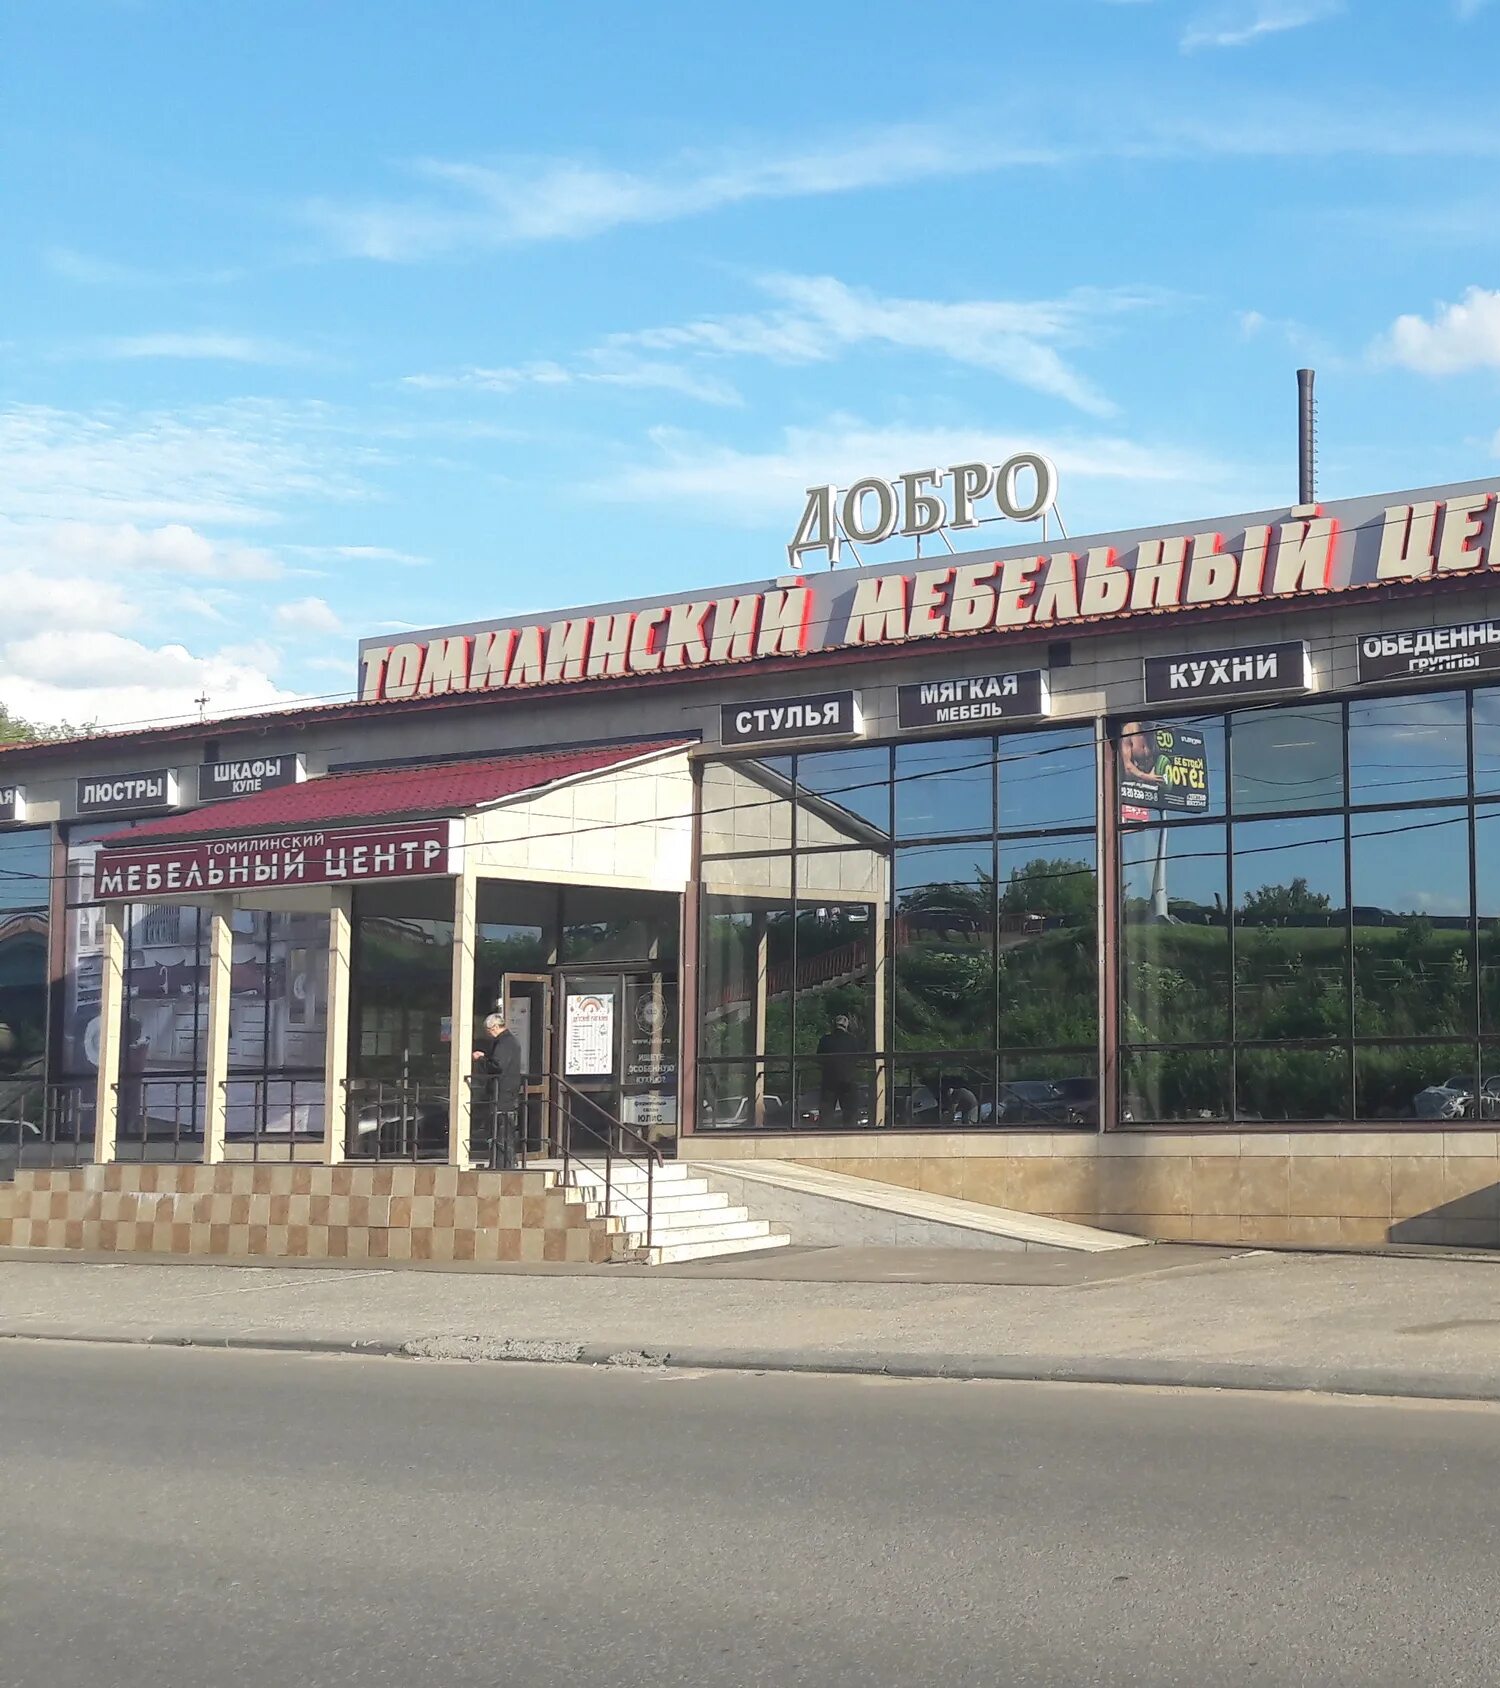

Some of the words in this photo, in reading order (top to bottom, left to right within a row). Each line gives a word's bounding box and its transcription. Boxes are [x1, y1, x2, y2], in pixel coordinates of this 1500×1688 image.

[787, 452, 1058, 569] ДОБРО
[360, 576, 814, 701] ТОМИЛИНСКИЙ
[842, 503, 1338, 645] МЕБЕЛЬНЫЙ
[1169, 653, 1278, 690] КУХНИ
[1408, 652, 1480, 674] ГРУППЫ
[919, 675, 1019, 705] МЯГКАЯ
[735, 701, 840, 735] СТУЛЬЯ
[936, 703, 1003, 723] МЕБЕЛЬ
[213, 758, 281, 783] ШКАФЫ
[82, 777, 163, 804] ЛЮСТРЫ
[232, 778, 262, 794] КУПЕ
[205, 833, 324, 856] ТОМИЛИНСКИЙ
[100, 849, 305, 894] МЕБЕЛЬНЫЙ
[325, 839, 441, 878] ЦЕНТР
[637, 1114, 663, 1123] ЮЛИС
